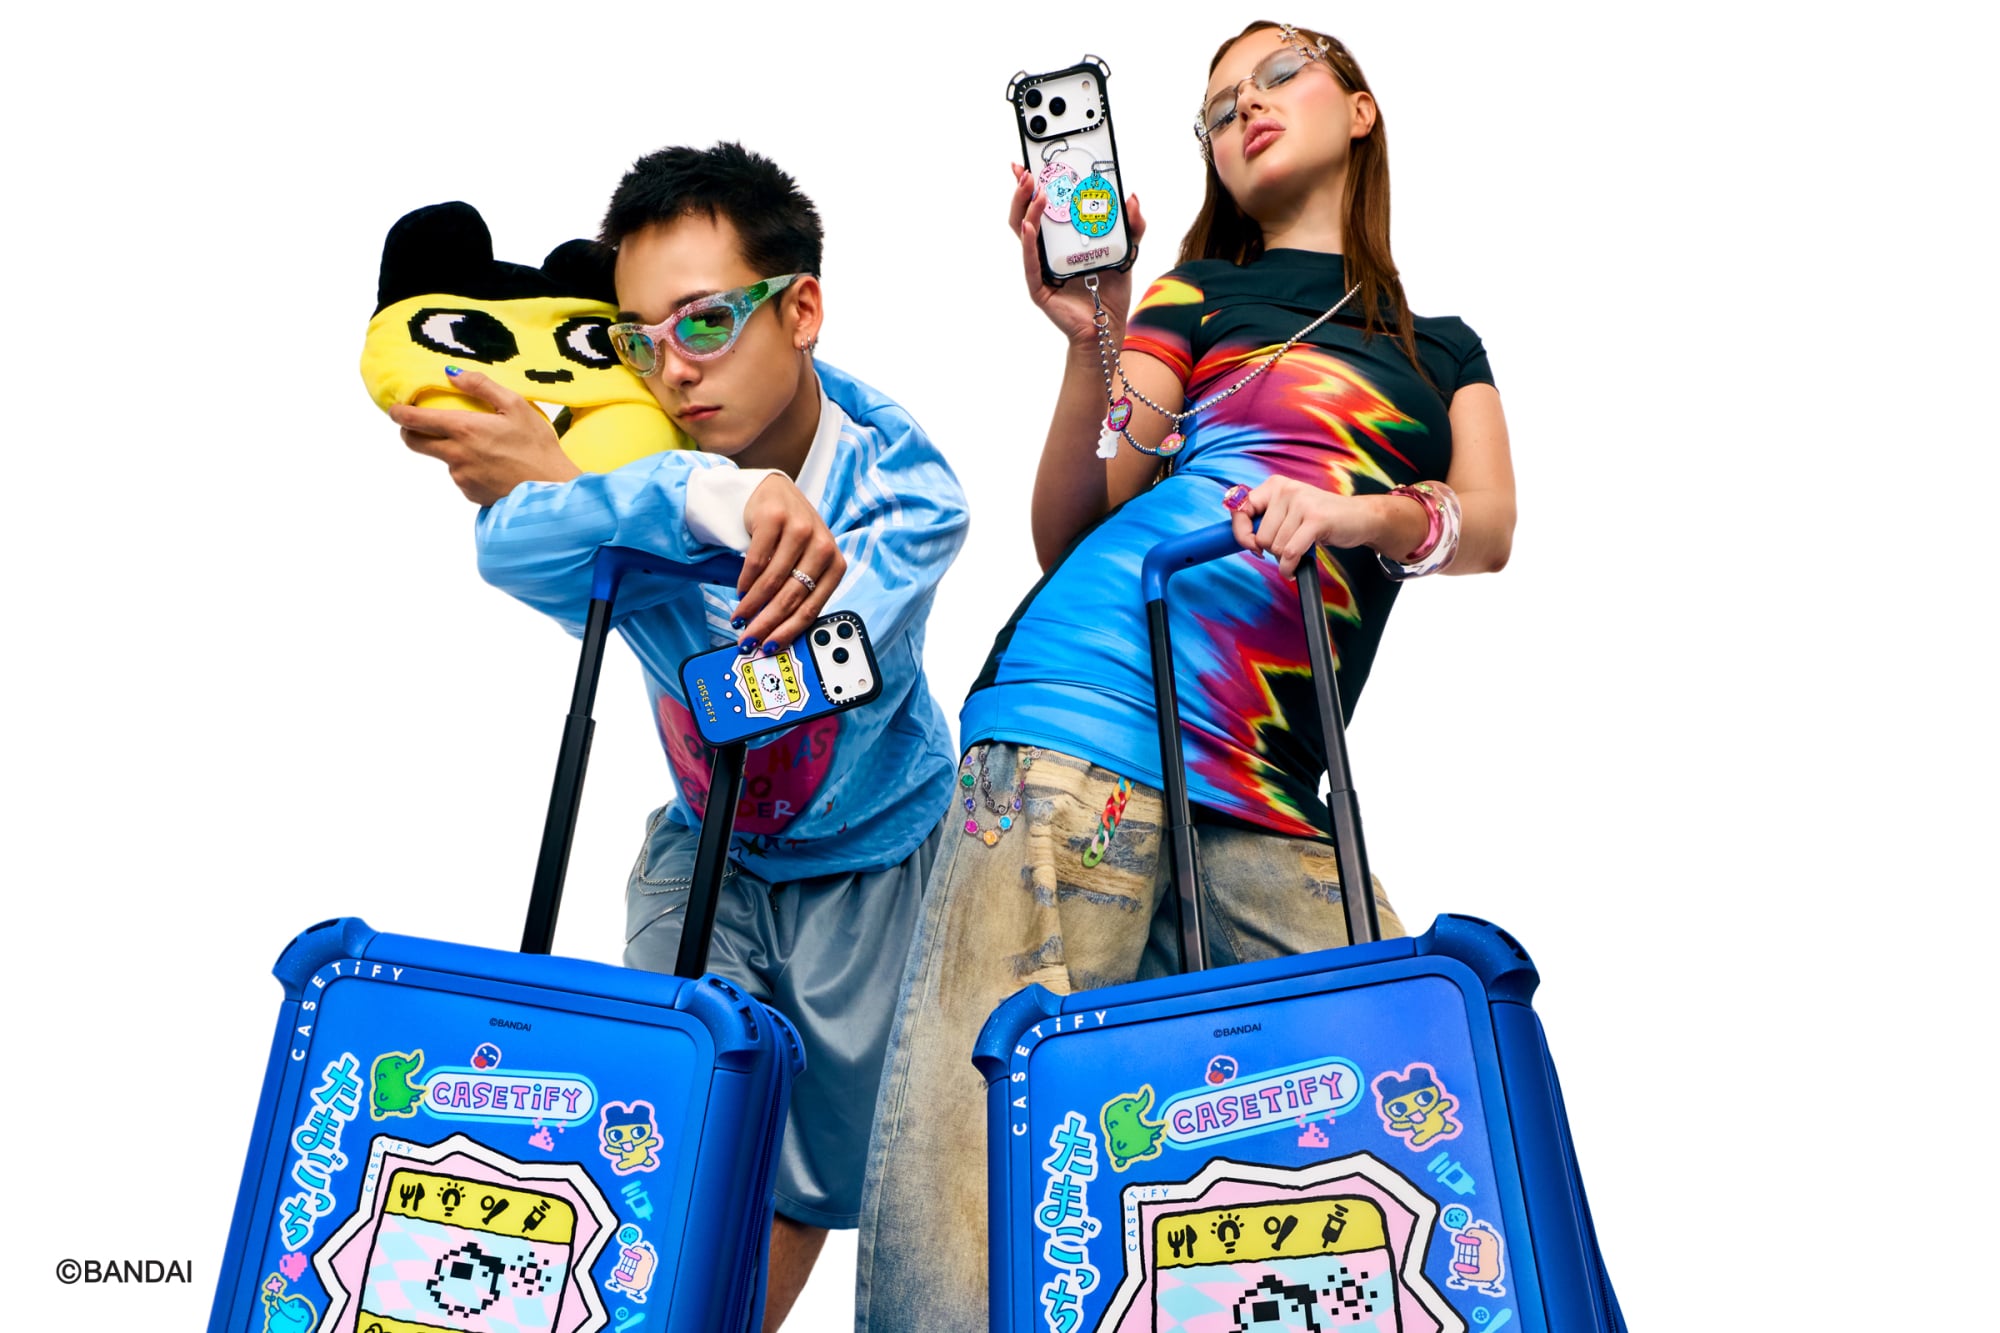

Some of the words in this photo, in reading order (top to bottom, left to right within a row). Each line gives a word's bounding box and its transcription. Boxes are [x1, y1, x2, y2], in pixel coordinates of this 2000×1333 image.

[280, 1056, 358, 1247] たまごっち
[432, 1081, 583, 1114] CASETiFY
[1173, 1071, 1344, 1135] CASETiFY
[1039, 1116, 1097, 1333] たまごっち
